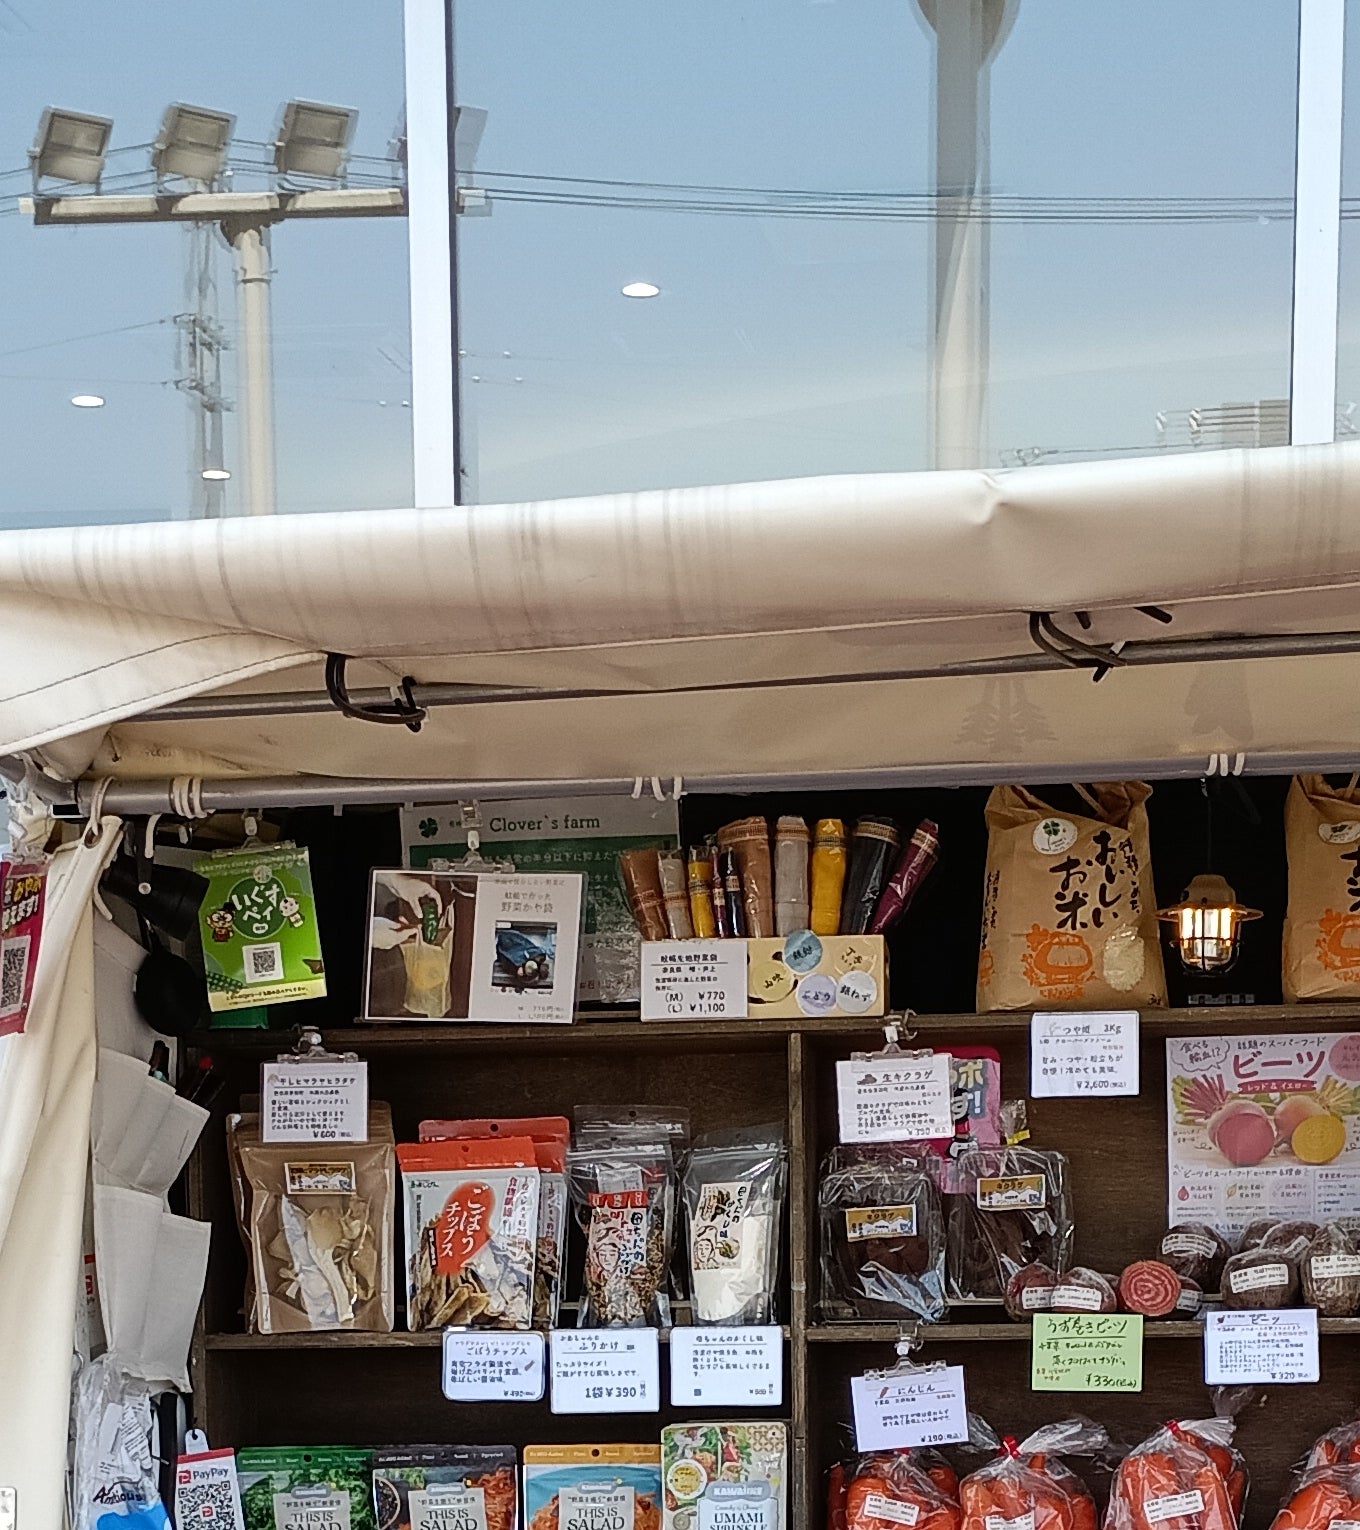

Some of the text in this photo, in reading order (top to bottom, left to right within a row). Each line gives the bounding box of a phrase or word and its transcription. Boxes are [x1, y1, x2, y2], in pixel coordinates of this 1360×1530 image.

[562, 815, 601, 829] farm
[1092, 829, 1126, 928] おいしい
[1049, 855, 1089, 931] お米
[500, 901, 554, 914] 野菜かや袋
[698, 990, 726, 1001] ¥770
[689, 1003, 726, 1015] ¥1,100
[1062, 1024, 1091, 1034] つや姫
[1233, 1050, 1326, 1079] ビーツ
[882, 1070, 933, 1083] 生キクラゲ
[460, 1184, 489, 1254] ごぼう
[440, 1201, 461, 1258] チップス
[579, 1341, 619, 1351] ふりかけ
[897, 1384, 936, 1396] にんじん
[193, 1467, 229, 1480] PayPay
[291, 1510, 334, 1523] THIS IS
[426, 1508, 469, 1520] THIS IS
[576, 1507, 619, 1519] THIS IS
[714, 1512, 764, 1524] UMAMI
